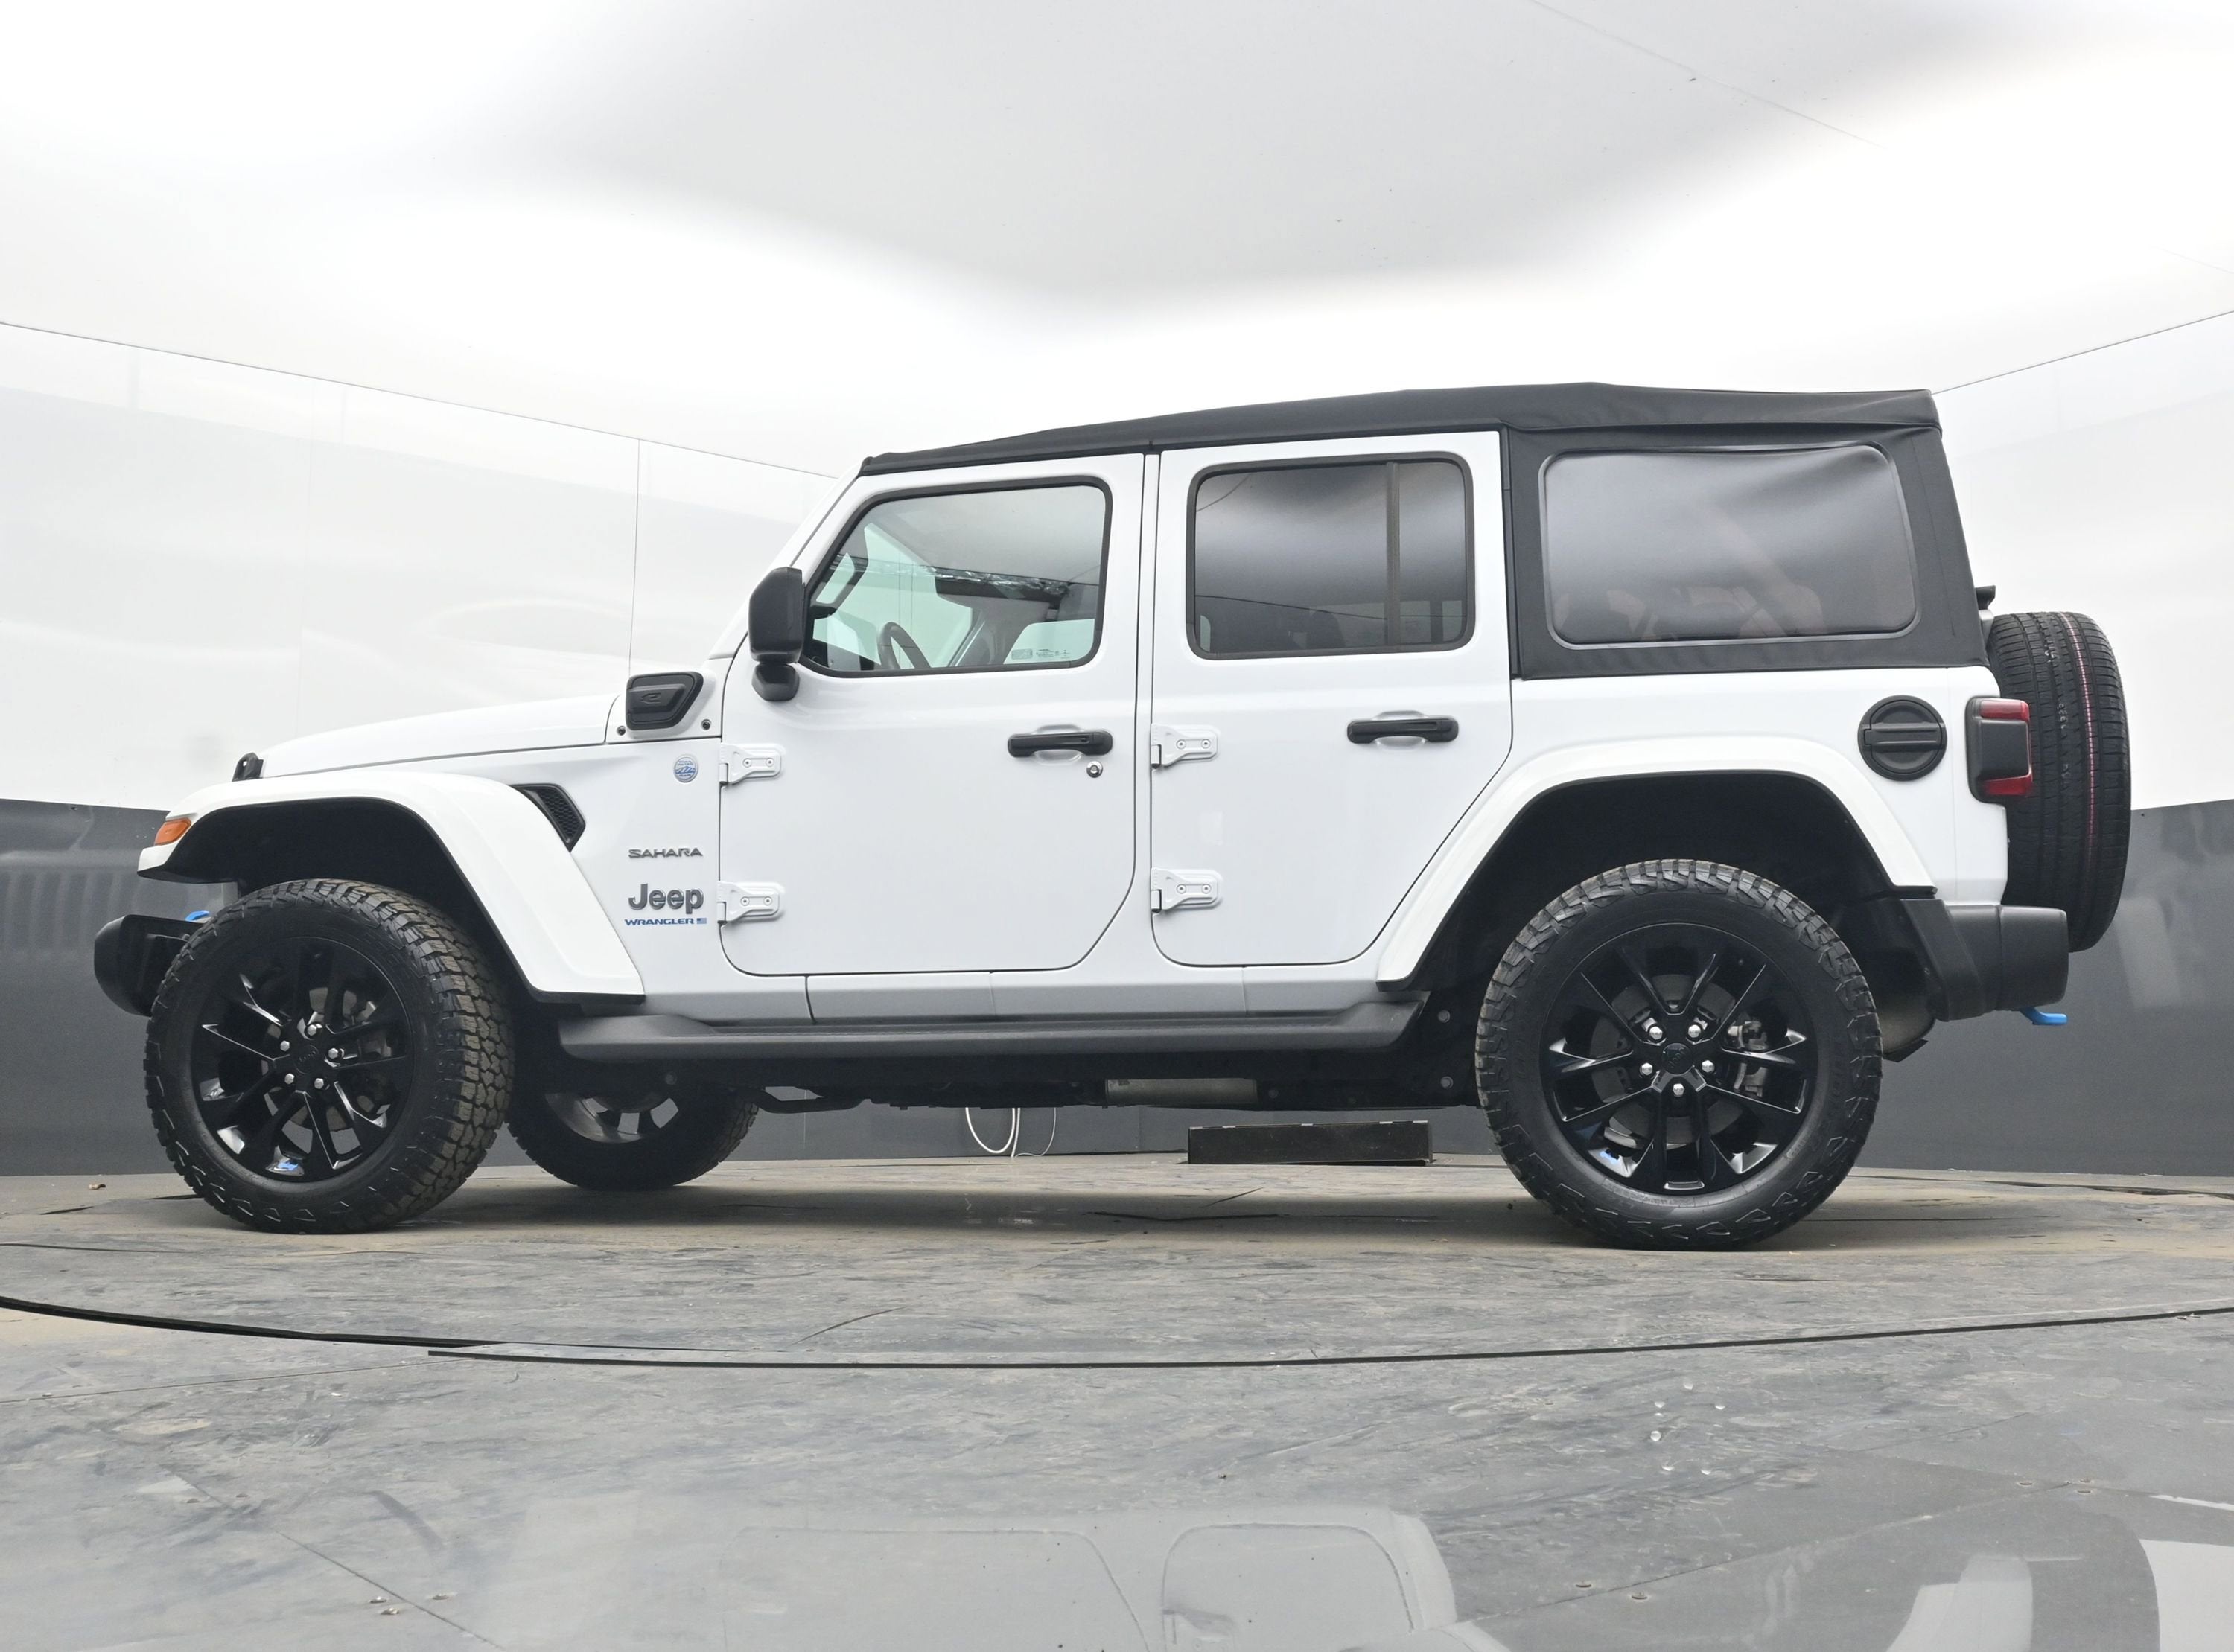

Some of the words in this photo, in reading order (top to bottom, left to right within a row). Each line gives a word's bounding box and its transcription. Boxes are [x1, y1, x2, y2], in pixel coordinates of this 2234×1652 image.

[628, 847, 703, 858] SAHARA
[628, 883, 704, 915] Jeep
[624, 917, 694, 925] WRANGLER
